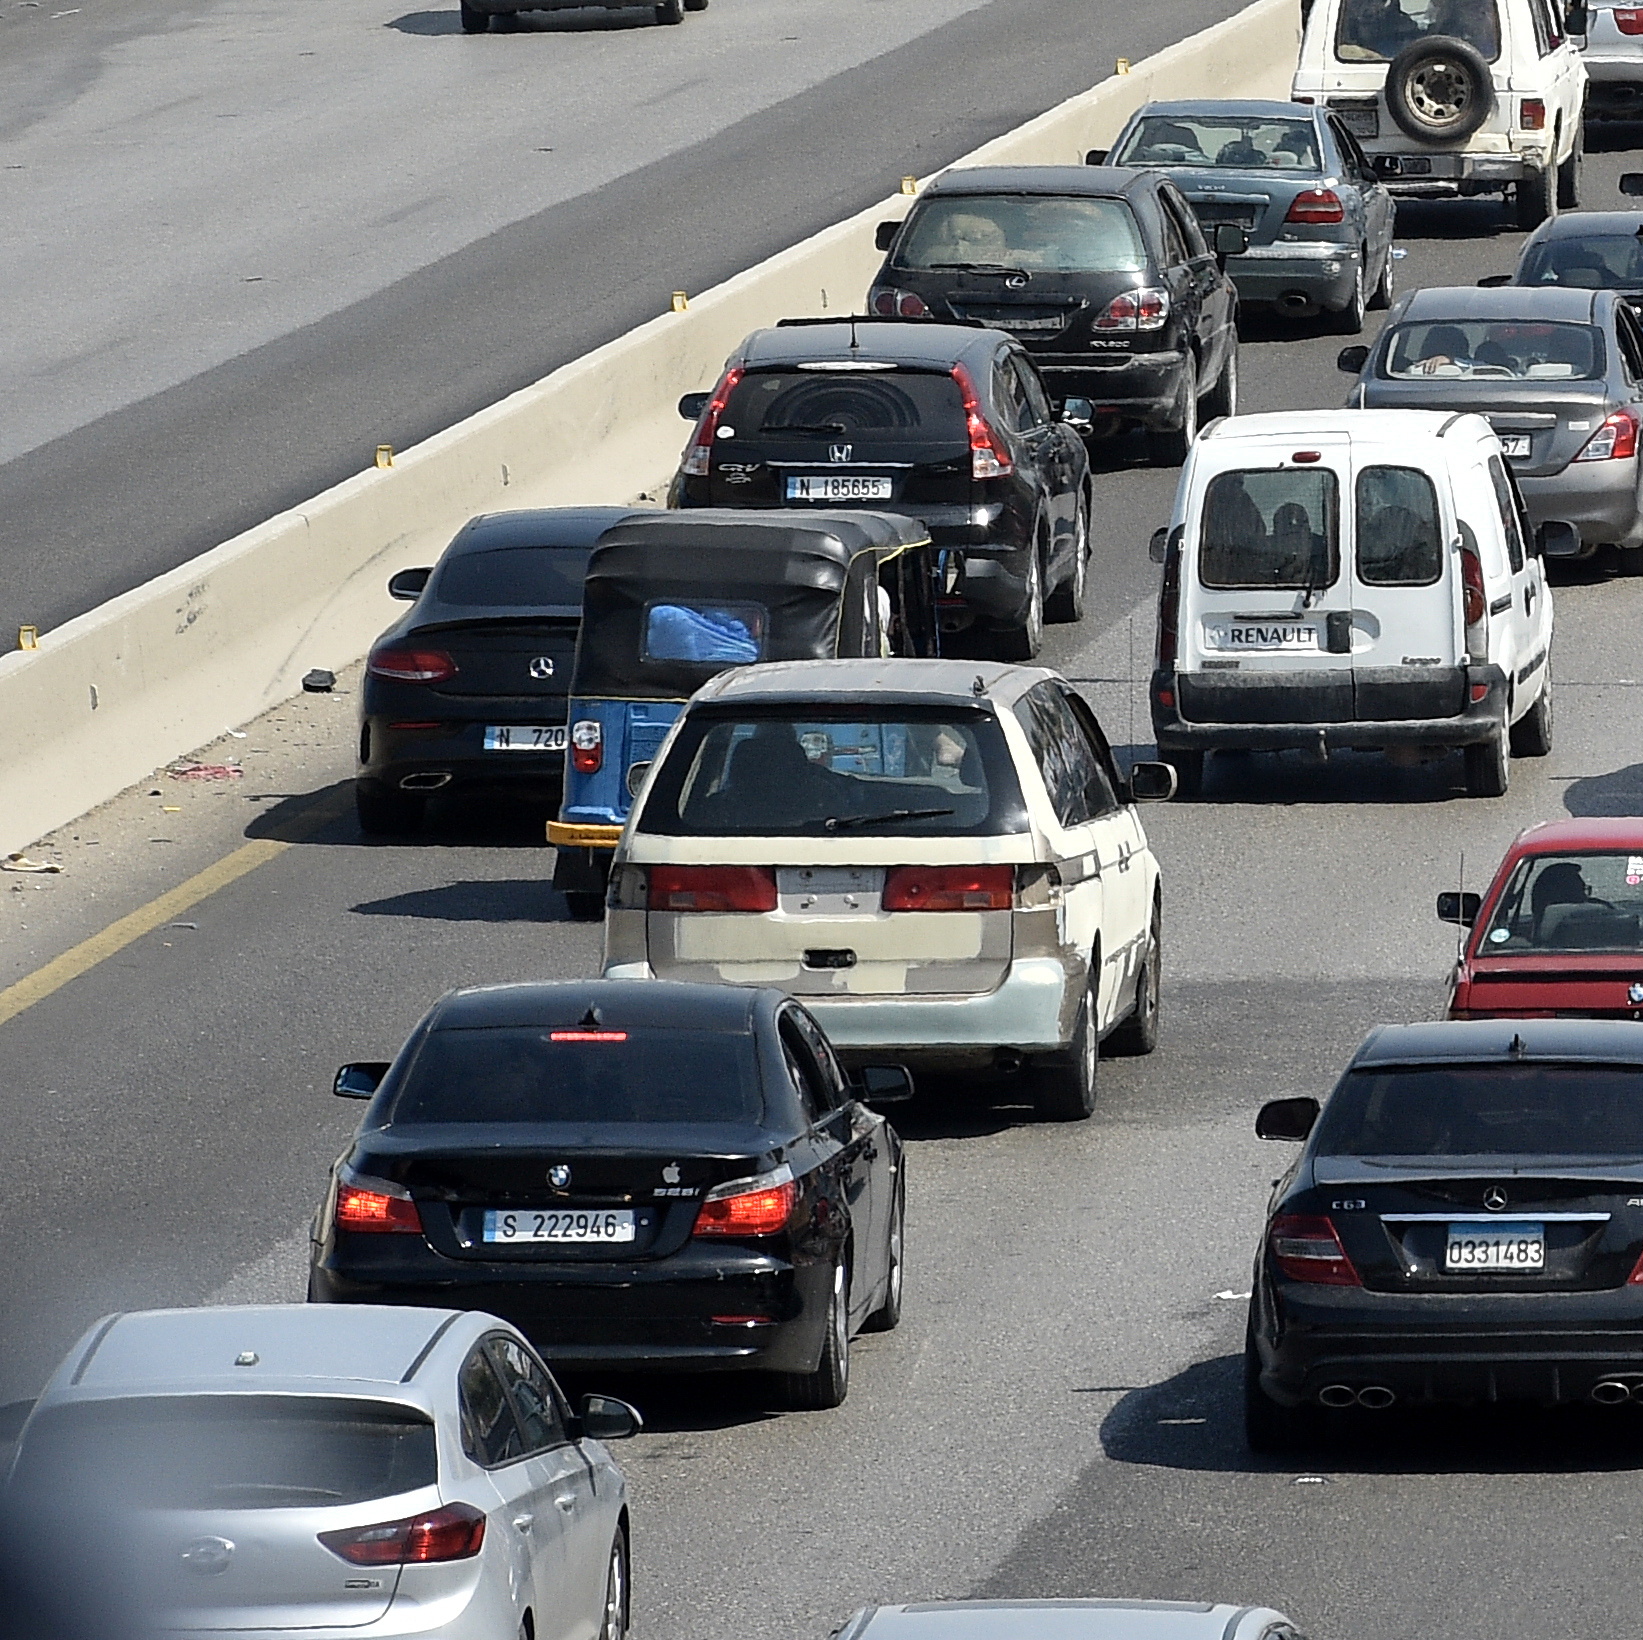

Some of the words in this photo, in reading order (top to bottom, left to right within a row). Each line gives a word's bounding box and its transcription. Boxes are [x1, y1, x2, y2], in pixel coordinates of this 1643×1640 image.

[800, 479, 811, 496] N
[823, 478, 881, 496] 185655
[1231, 626, 1316, 644] RENAULT
[497, 728, 511, 748] N
[1331, 1199, 1365, 1209] C63
[502, 1214, 517, 1238] S
[532, 1213, 617, 1238] 222946
